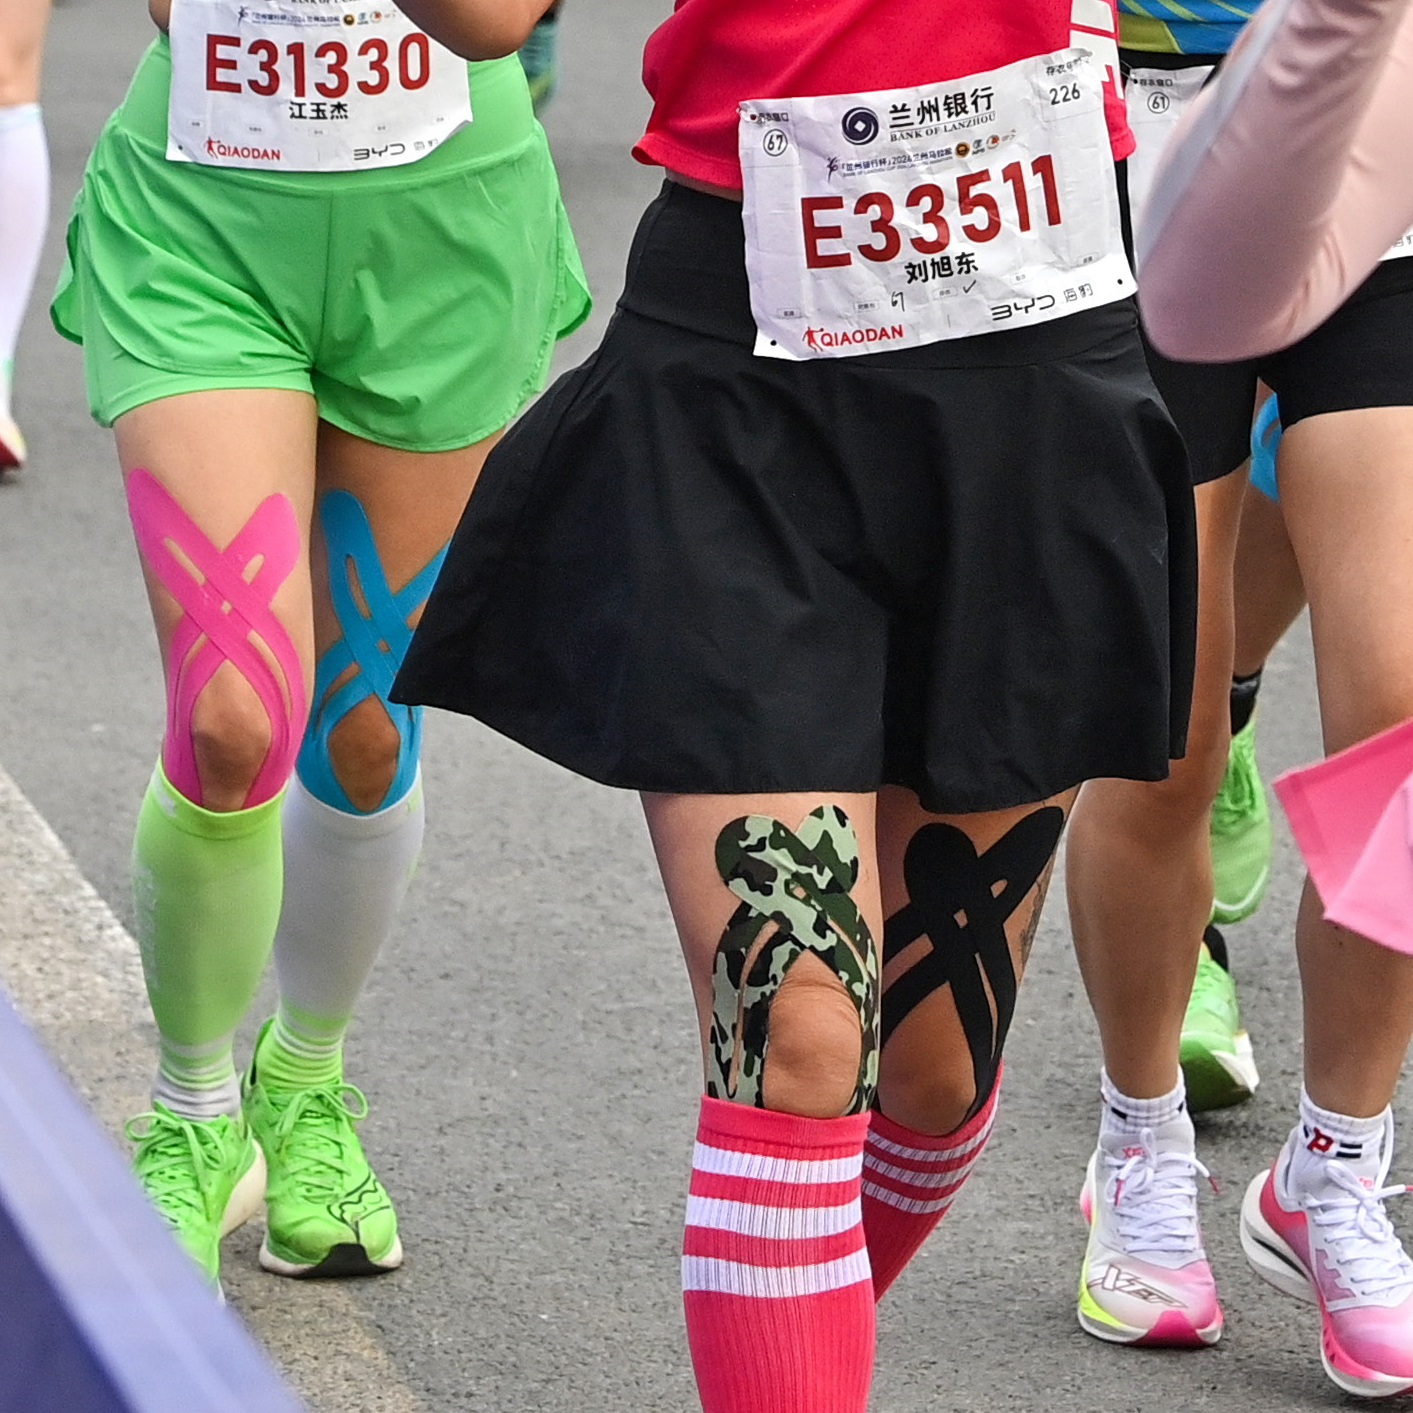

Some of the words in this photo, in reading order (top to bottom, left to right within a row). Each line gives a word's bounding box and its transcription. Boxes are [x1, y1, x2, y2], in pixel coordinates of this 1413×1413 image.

[206, 32, 430, 99] E31330
[1049, 82, 1081, 106] 226
[288, 101, 349, 121] 江玉杰
[889, 86, 996, 130] 兰州银行
[890, 128, 923, 143] BANK
[925, 125, 942, 137] OF
[943, 111, 996, 133] LANZHOU
[217, 144, 281, 161] QIAODAN
[353, 143, 406, 161] BYD
[800, 154, 1062, 270] E33511
[904, 251, 979, 285] 刘旭东
[991, 294, 1056, 321] BYD
[821, 323, 904, 347] QIAODAN
